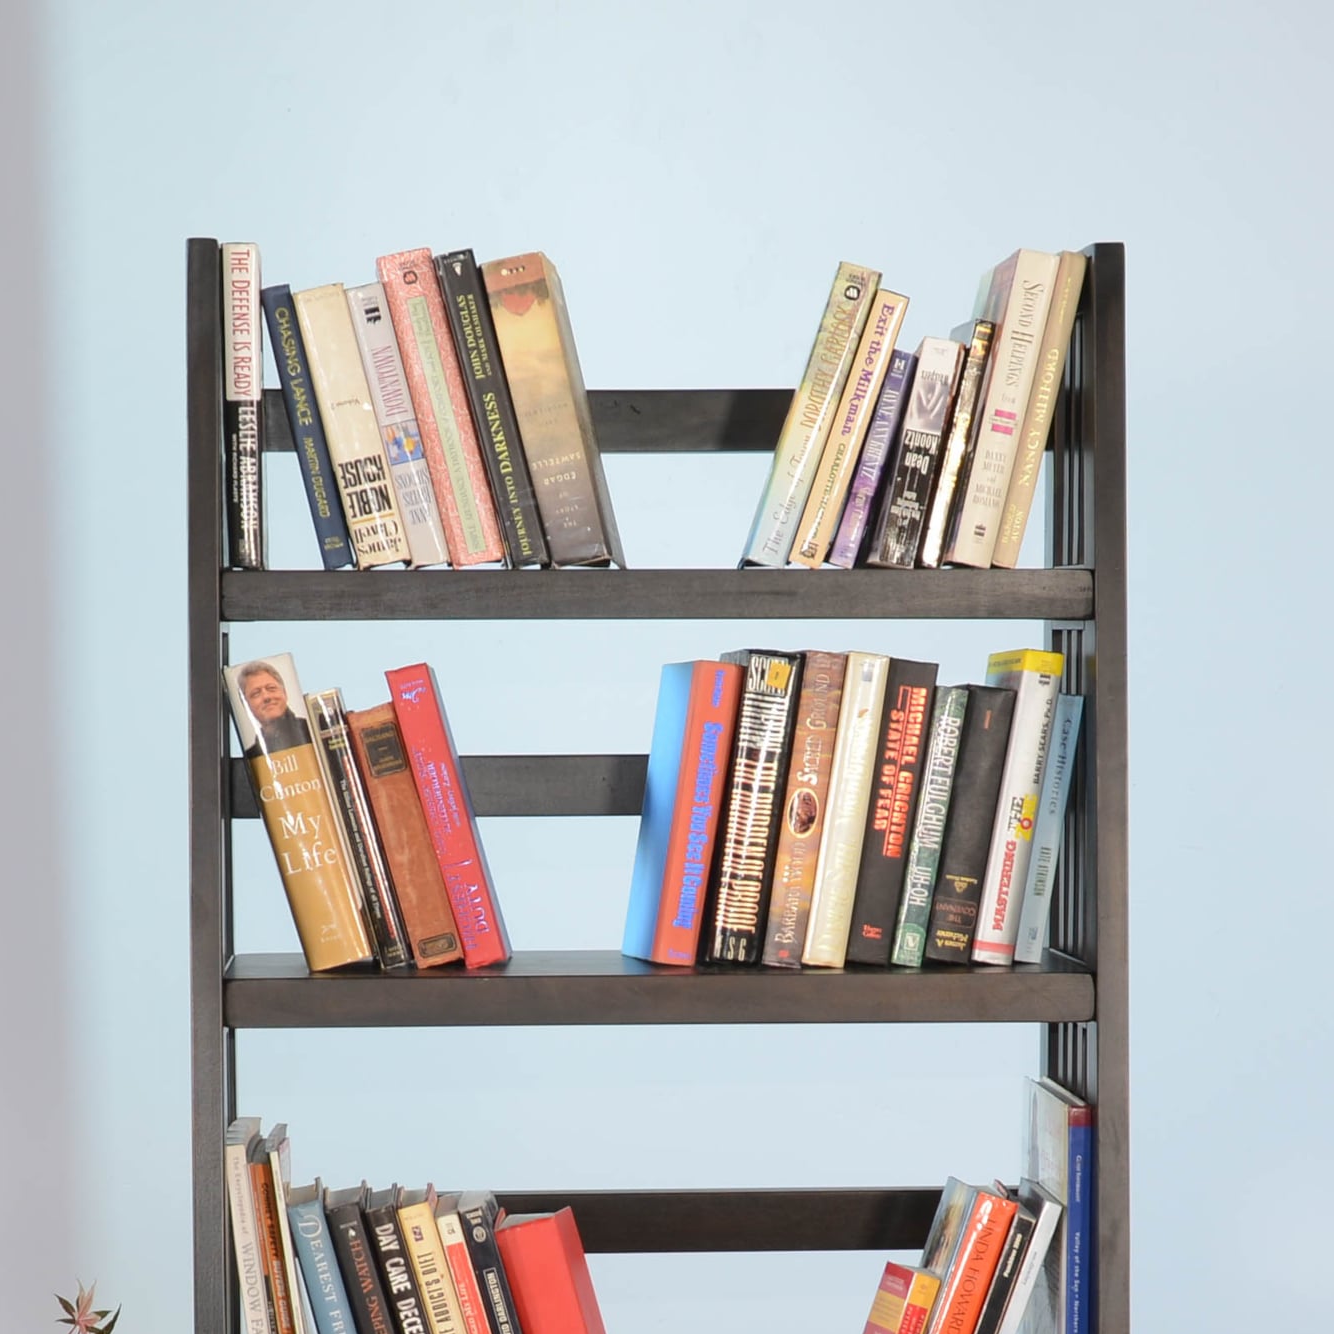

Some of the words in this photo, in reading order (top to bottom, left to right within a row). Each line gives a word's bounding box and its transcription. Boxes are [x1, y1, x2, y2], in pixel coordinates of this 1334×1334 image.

[231, 250, 250, 272] THE
[231, 279, 251, 337] DEFENSE
[456, 294, 477, 348] DOUGLAS
[873, 302, 894, 339] Exit
[1014, 279, 1044, 328] SECOND
[232, 341, 251, 351] IS
[273, 306, 302, 376] CHASING
[289, 378, 313, 426] LANCE
[468, 348, 485, 379] JOHN
[864, 339, 882, 367] the
[1001, 330, 1037, 389] HELPINGS
[233, 355, 251, 396] READY
[370, 344, 408, 417] DOWNTOWN
[798, 367, 839, 431] DOROTHY
[840, 367, 873, 438] Milkman
[1019, 426, 1043, 486] NANCY
[1032, 347, 1060, 422] MITFORD
[237, 406, 256, 450] LESLIE
[480, 390, 513, 474] DARKNESS
[903, 430, 938, 454] Koontz
[302, 436, 320, 474] MARTIN
[311, 473, 330, 518] DUGARD
[338, 454, 385, 489] HOUSE
[530, 451, 581, 470] SAWTELLE
[542, 470, 576, 484] EDGAR
[904, 452, 929, 474] Dean
[238, 456, 258, 529] ABRAMSON
[346, 484, 392, 518] NOBLE
[503, 474, 518, 504] INTO
[511, 505, 533, 555] JOURNEY
[805, 672, 831, 730] GROUND
[884, 709, 904, 760] STATE
[900, 686, 926, 766] MICHAEL
[931, 715, 960, 774] ROBERT
[1059, 718, 1072, 748] Case
[271, 754, 298, 775] Bill
[693, 720, 723, 803] Sometimes
[880, 763, 896, 784] OF
[1032, 752, 1044, 783] BARRY
[1048, 753, 1067, 815] Histories
[258, 773, 321, 803] Clinton
[873, 788, 892, 830] FEAR
[279, 808, 324, 843] My
[689, 804, 712, 833] You
[885, 770, 913, 858] CRICHTON
[918, 775, 950, 850] FULGHUM
[1014, 793, 1037, 841] ZONE
[281, 838, 338, 876] Life
[683, 861, 704, 876] It
[685, 832, 708, 861] See
[992, 840, 1016, 930] MASTERING
[1007, 796, 1023, 832] THE
[464, 881, 491, 934] DUTY
[673, 874, 701, 929] Coming
[908, 865, 933, 907] UH-OH
[774, 883, 800, 944] BARBARA
[267, 1223, 280, 1258] SAFETY
[295, 1212, 340, 1306] DEAREST
[374, 1222, 399, 1253] DAY
[969, 1216, 997, 1264] LINDA
[240, 1242, 262, 1316] WINDOW
[348, 1238, 375, 1293] WATCH
[383, 1256, 411, 1294] CARE
[416, 1250, 437, 1275] DIET
[424, 1277, 451, 1324] ADDICT'S
[486, 1271, 508, 1323] DARLINGTON
